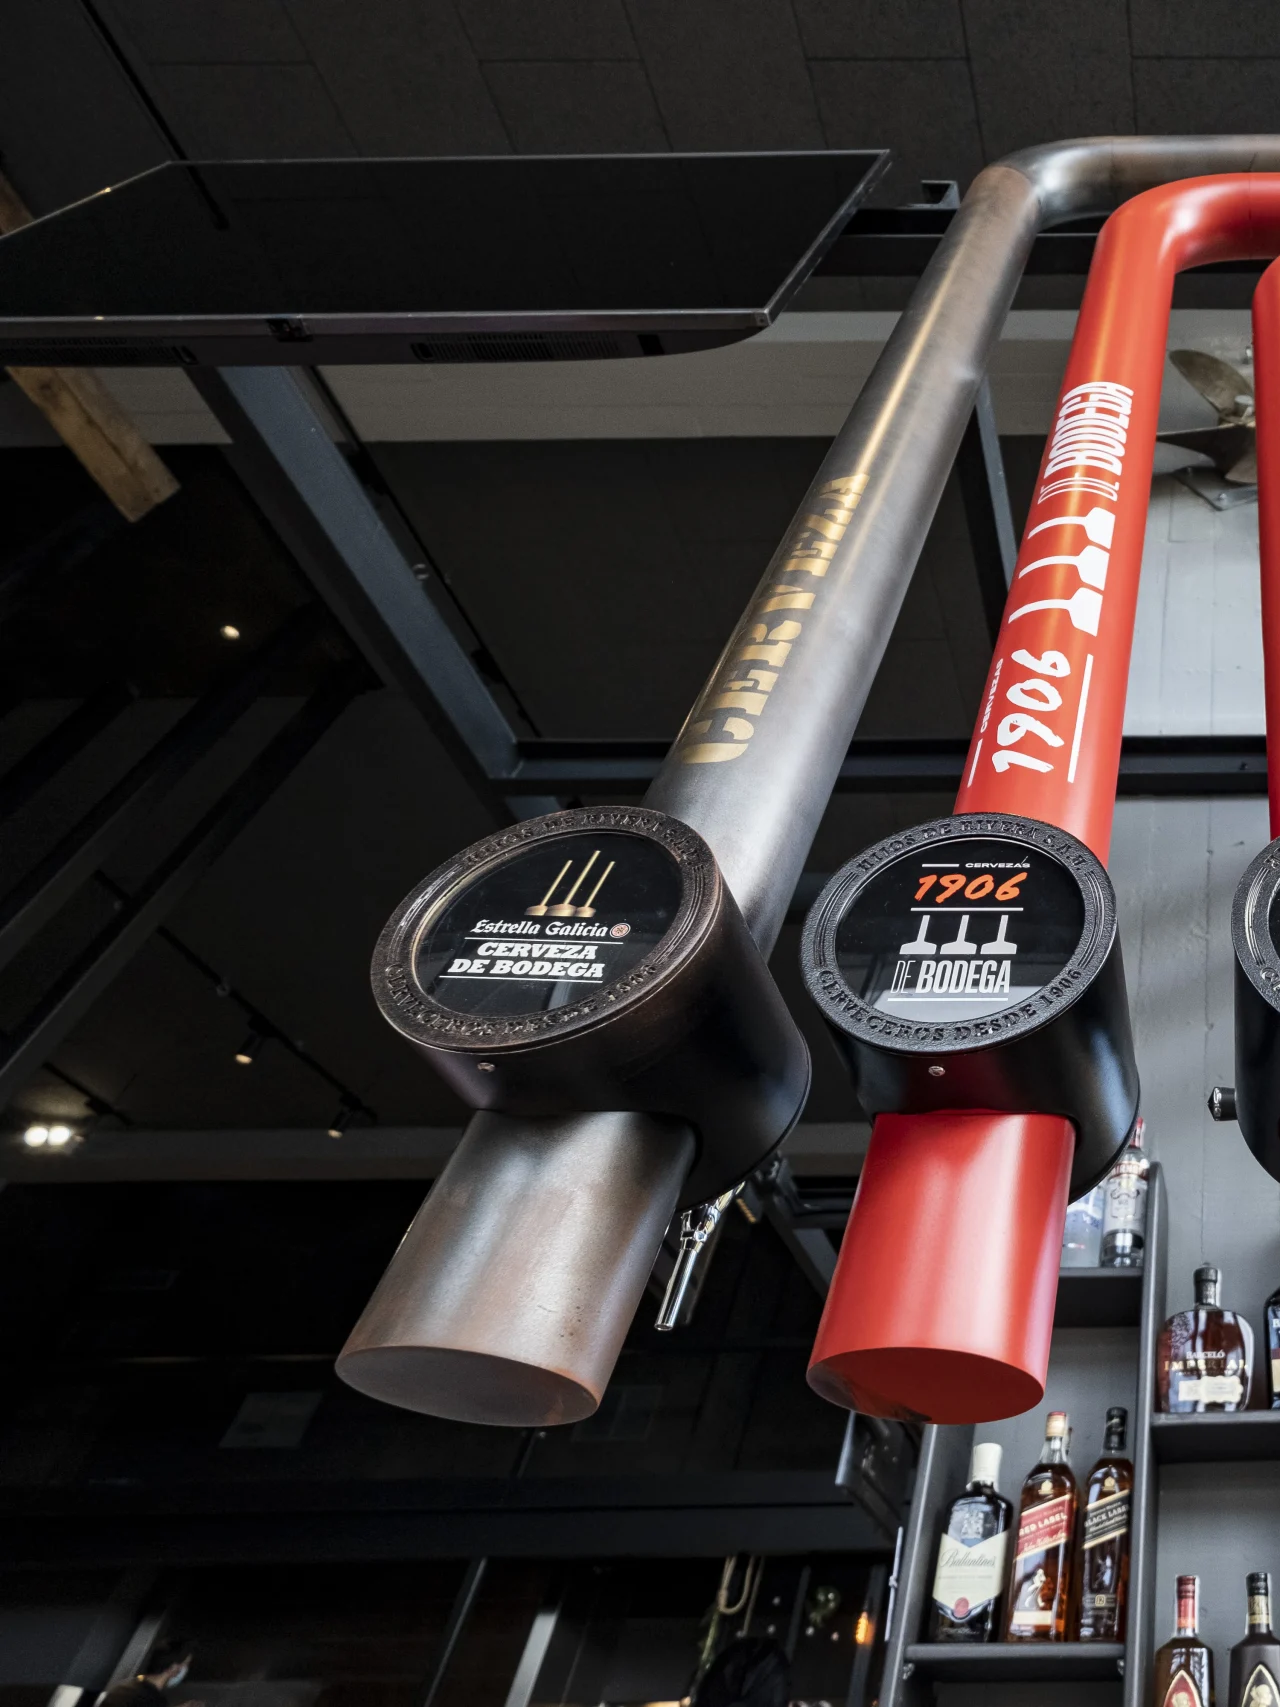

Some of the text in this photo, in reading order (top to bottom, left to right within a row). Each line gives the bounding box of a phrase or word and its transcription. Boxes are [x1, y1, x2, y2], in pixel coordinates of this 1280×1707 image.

[1037, 381, 1135, 505] DE BODEGA
[682, 472, 870, 765] CERVEZA
[980, 657, 1004, 734] CERVEZAS
[991, 648, 1072, 774] 1906
[921, 823, 952, 839] DE
[960, 820, 1040, 839] RIVERA
[914, 871, 1028, 904] 1906
[470, 919, 609, 938] Estrella Galicia
[476, 942, 599, 960] CERVEZA
[447, 958, 605, 978] DE BODEGA
[890, 960, 1012, 994] DE BODEGA
[818, 969, 1083, 1042] CERVECEROS DESDE 1906
[1186, 1350, 1226, 1360] BARCELÓ
[1018, 1511, 1068, 1537] RED LABEL
